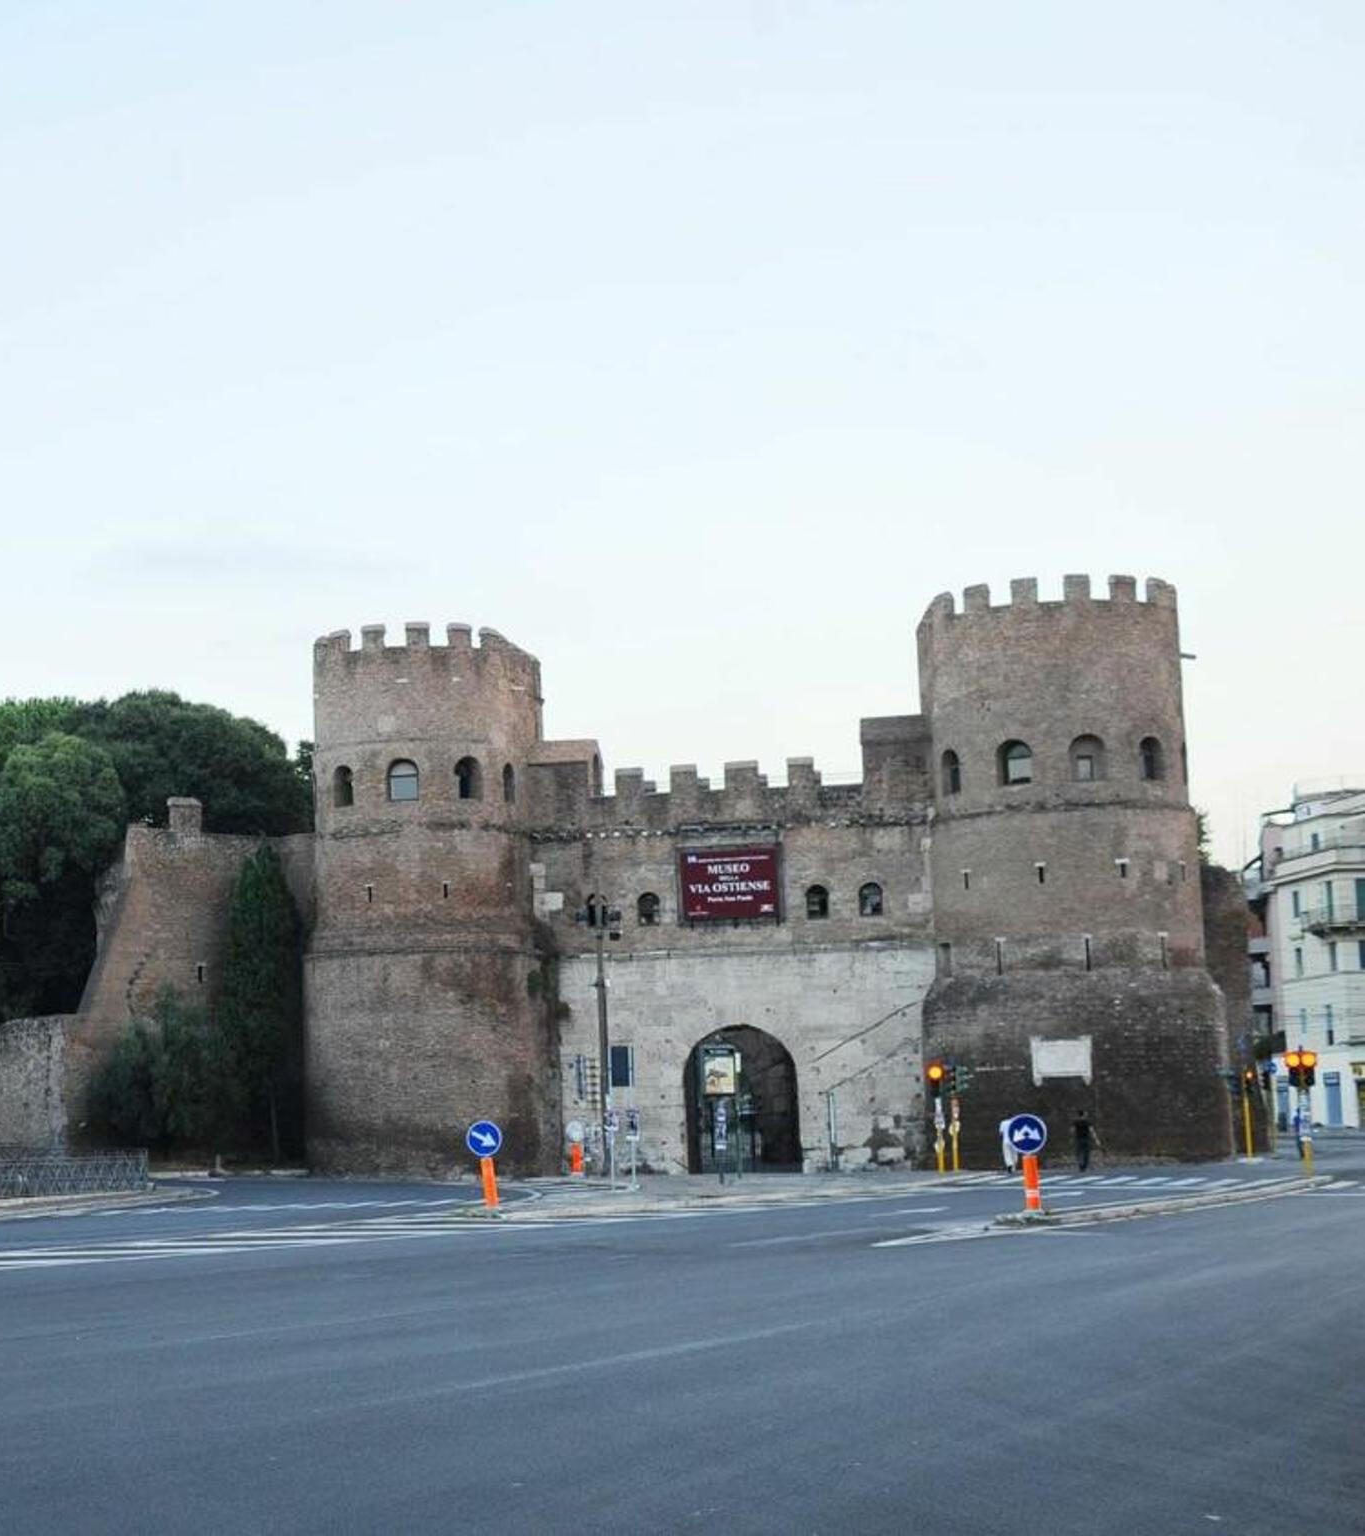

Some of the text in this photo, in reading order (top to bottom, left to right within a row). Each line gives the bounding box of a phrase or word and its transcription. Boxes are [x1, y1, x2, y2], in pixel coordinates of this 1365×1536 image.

[707, 863, 750, 875] MUSEO
[689, 881, 771, 893] VIA OSTIENSE
